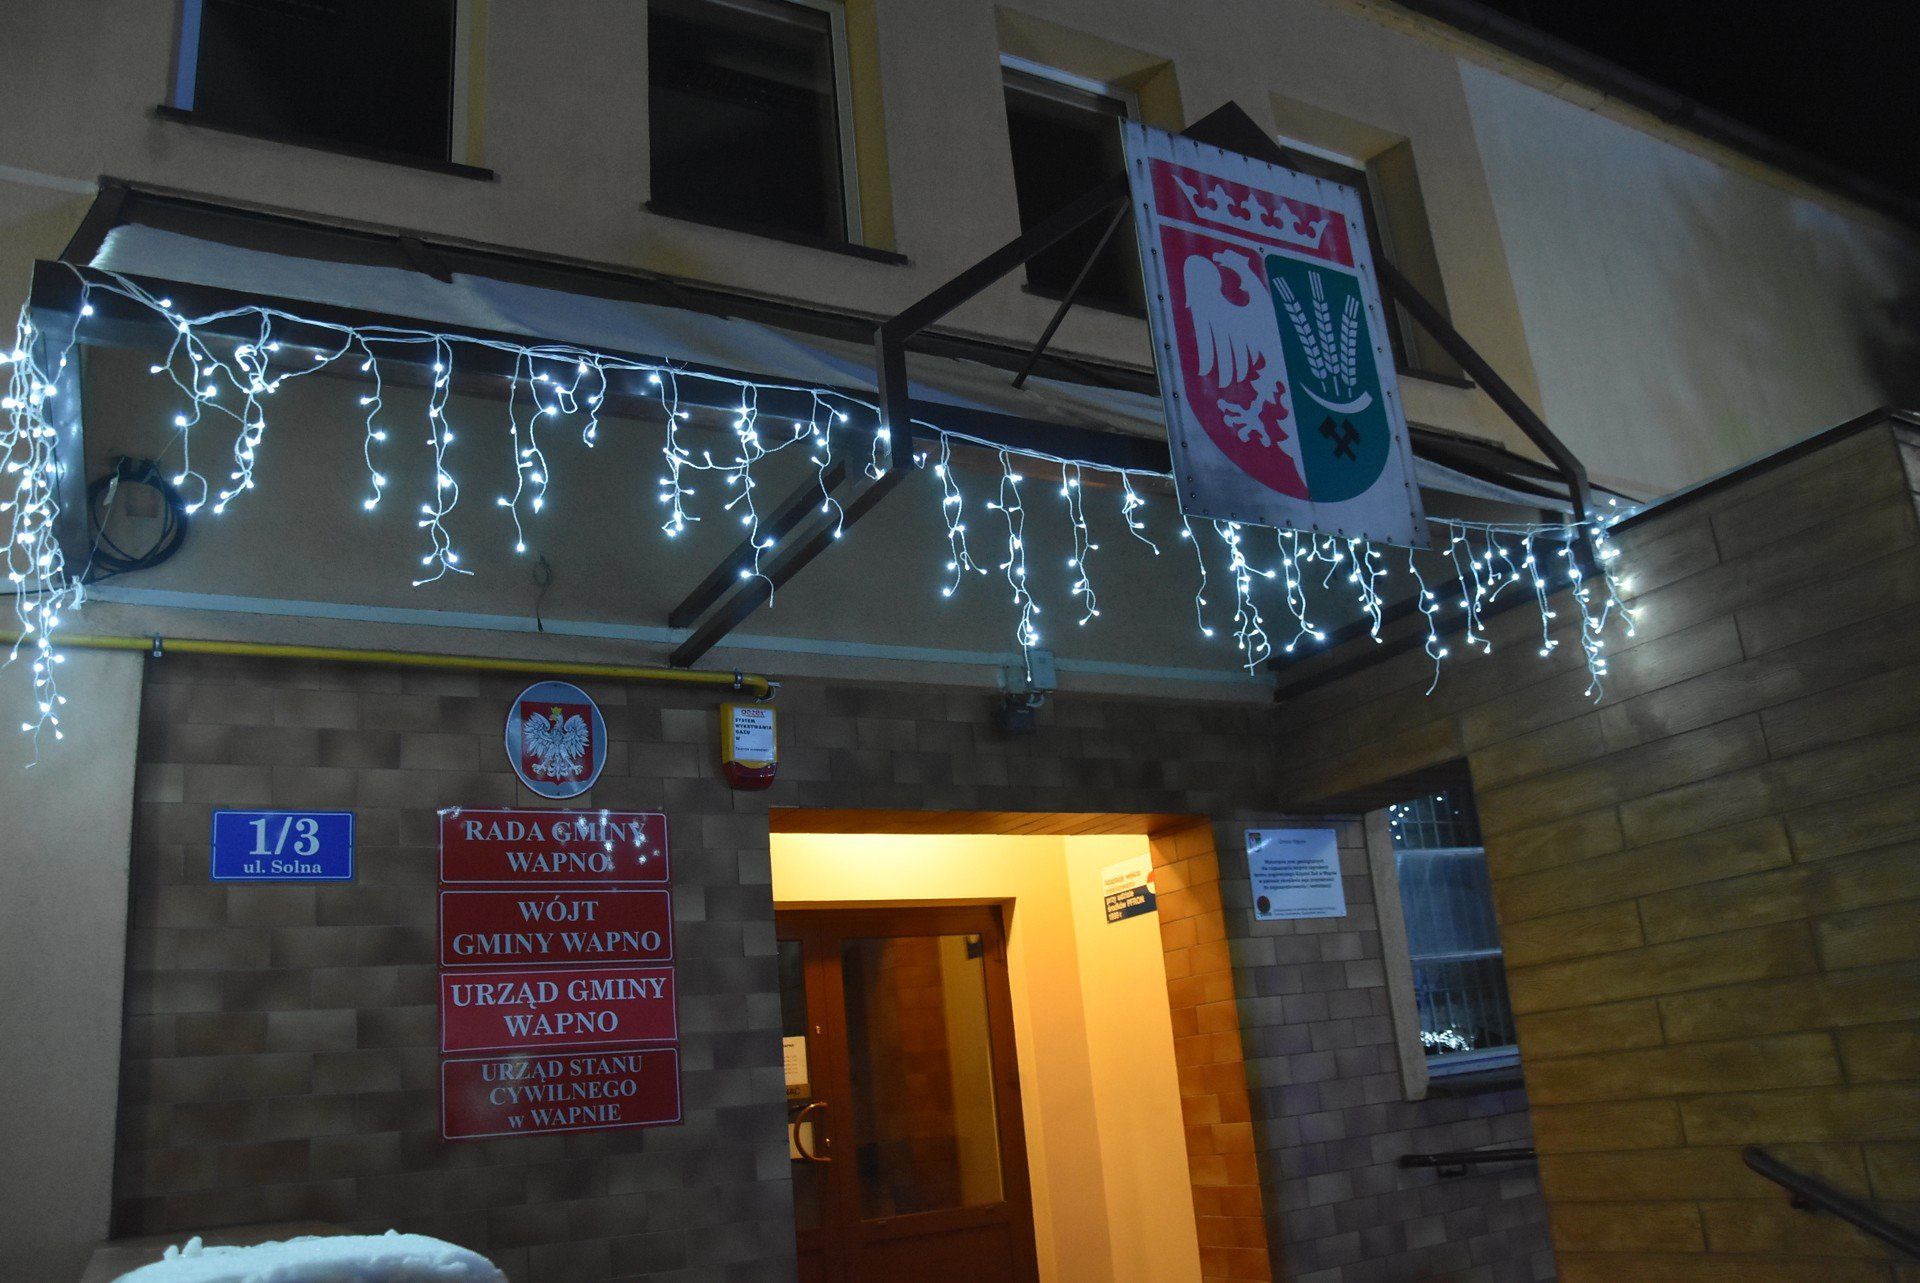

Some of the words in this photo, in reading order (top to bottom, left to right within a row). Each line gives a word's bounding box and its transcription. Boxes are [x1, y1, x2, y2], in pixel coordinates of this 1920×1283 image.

[249, 816, 320, 856] 1/3
[465, 820, 546, 842] RADA
[551, 821, 646, 843] GMINY
[243, 860, 266, 874] ul.
[271, 859, 322, 874] Solna
[506, 852, 609, 873] WAPNO
[517, 895, 599, 923] WÓJT
[453, 932, 554, 956] GMINY
[560, 930, 661, 954] WAPNO
[450, 981, 559, 1009] URZĄD
[567, 977, 667, 1002] GMINY
[503, 1010, 619, 1037] WAPNO
[482, 1060, 564, 1082] URZĄD
[570, 1055, 643, 1077] STANU
[489, 1079, 637, 1106] CYWILNEGO
[507, 1115, 524, 1129] w
[530, 1103, 622, 1127] WAPNIE
